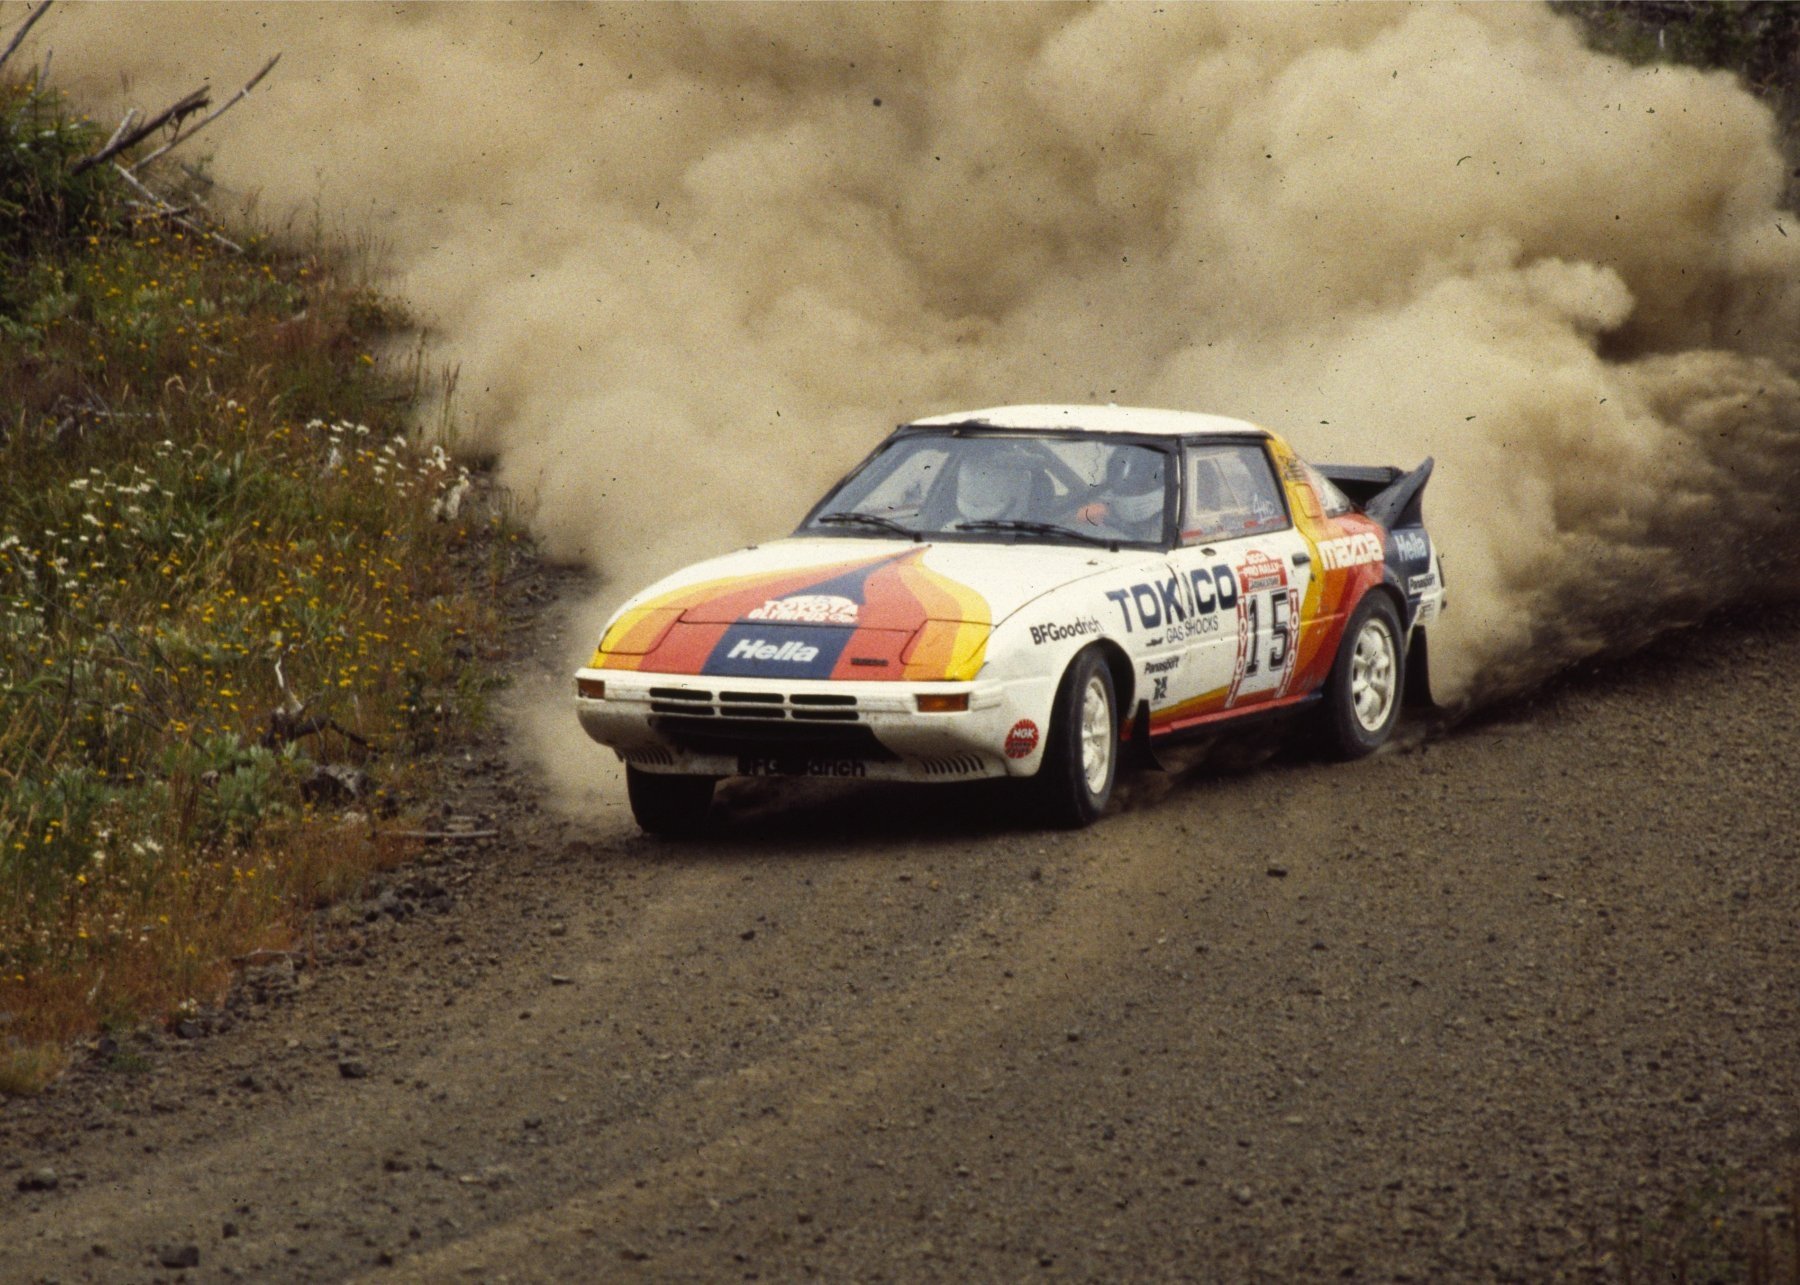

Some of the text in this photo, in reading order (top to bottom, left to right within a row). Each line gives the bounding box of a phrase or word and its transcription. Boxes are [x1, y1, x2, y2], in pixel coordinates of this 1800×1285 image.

[1394, 532, 1428, 561] Hella
[1105, 564, 1237, 632] TOKICO
[1029, 617, 1104, 645] BFGoodrich
[1166, 626, 1184, 644] GAS
[1184, 615, 1219, 637] SHOCKS
[1245, 588, 1289, 678] 15
[727, 638, 820, 663] Hella
[1011, 728, 1036, 739] NGK
